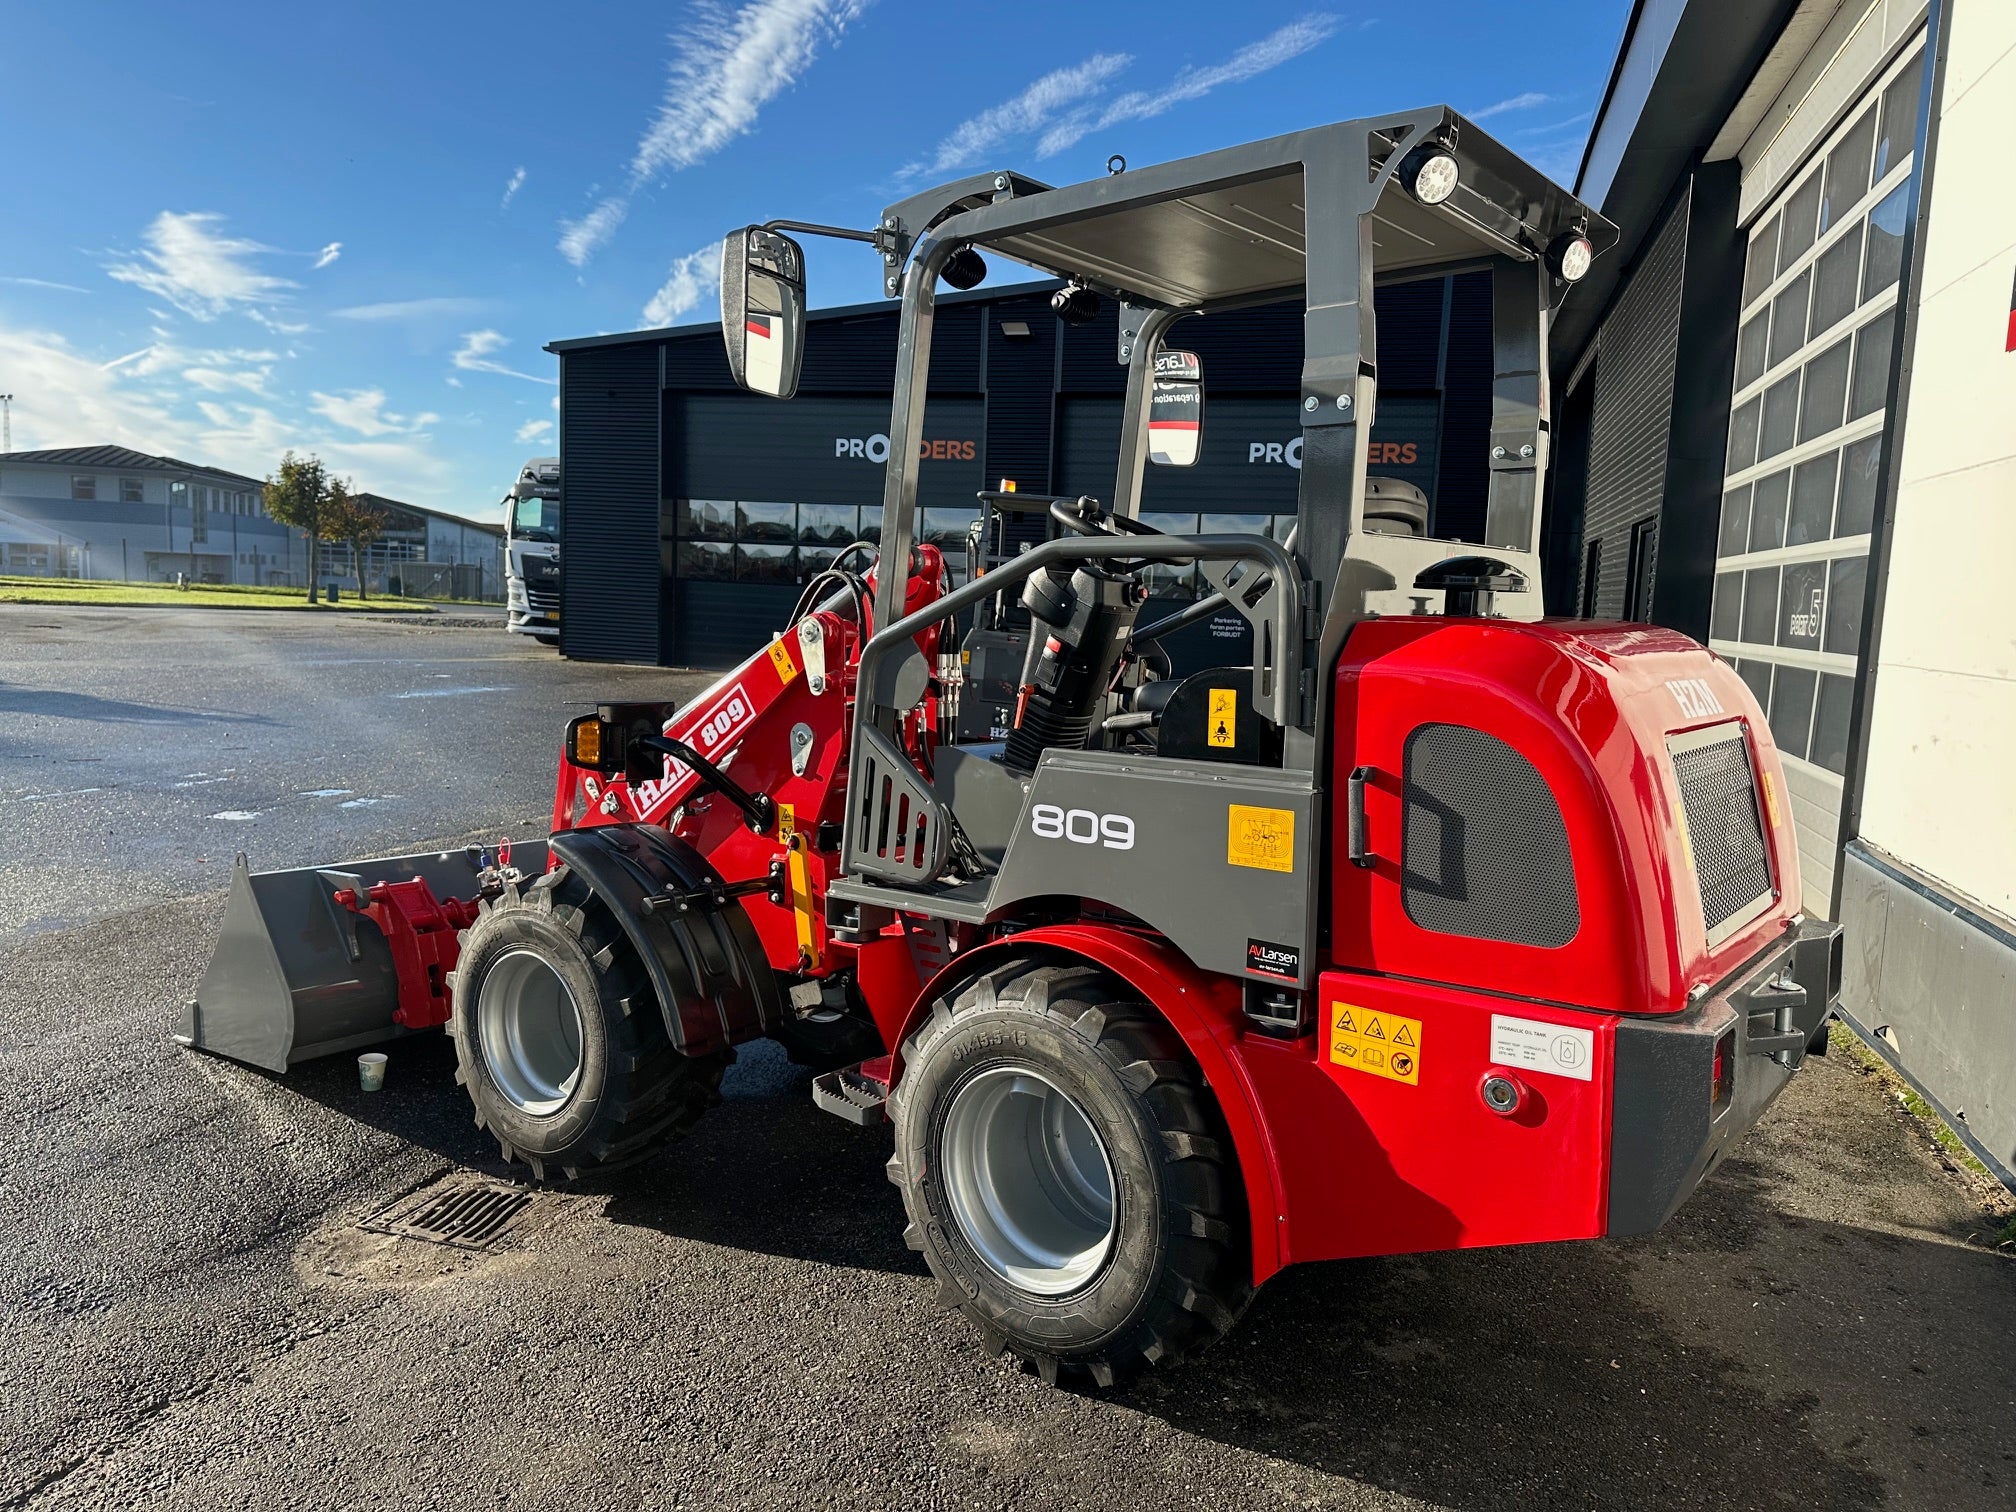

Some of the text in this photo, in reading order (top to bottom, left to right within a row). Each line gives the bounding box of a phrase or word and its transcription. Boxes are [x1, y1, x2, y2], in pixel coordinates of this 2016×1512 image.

[835, 433, 976, 464] PRODERS
[1249, 436, 1418, 469] PROERS
[542, 566, 560, 575] MA
[1214, 617, 1242, 626] Parkering
[1808, 589, 1821, 637] 5
[701, 697, 746, 747] 809
[989, 726, 1009, 738] HZ
[1031, 804, 1135, 850] 809
[1248, 944, 1298, 965] AVLarsen
[1497, 1025, 1524, 1035] HYDRAULIC
